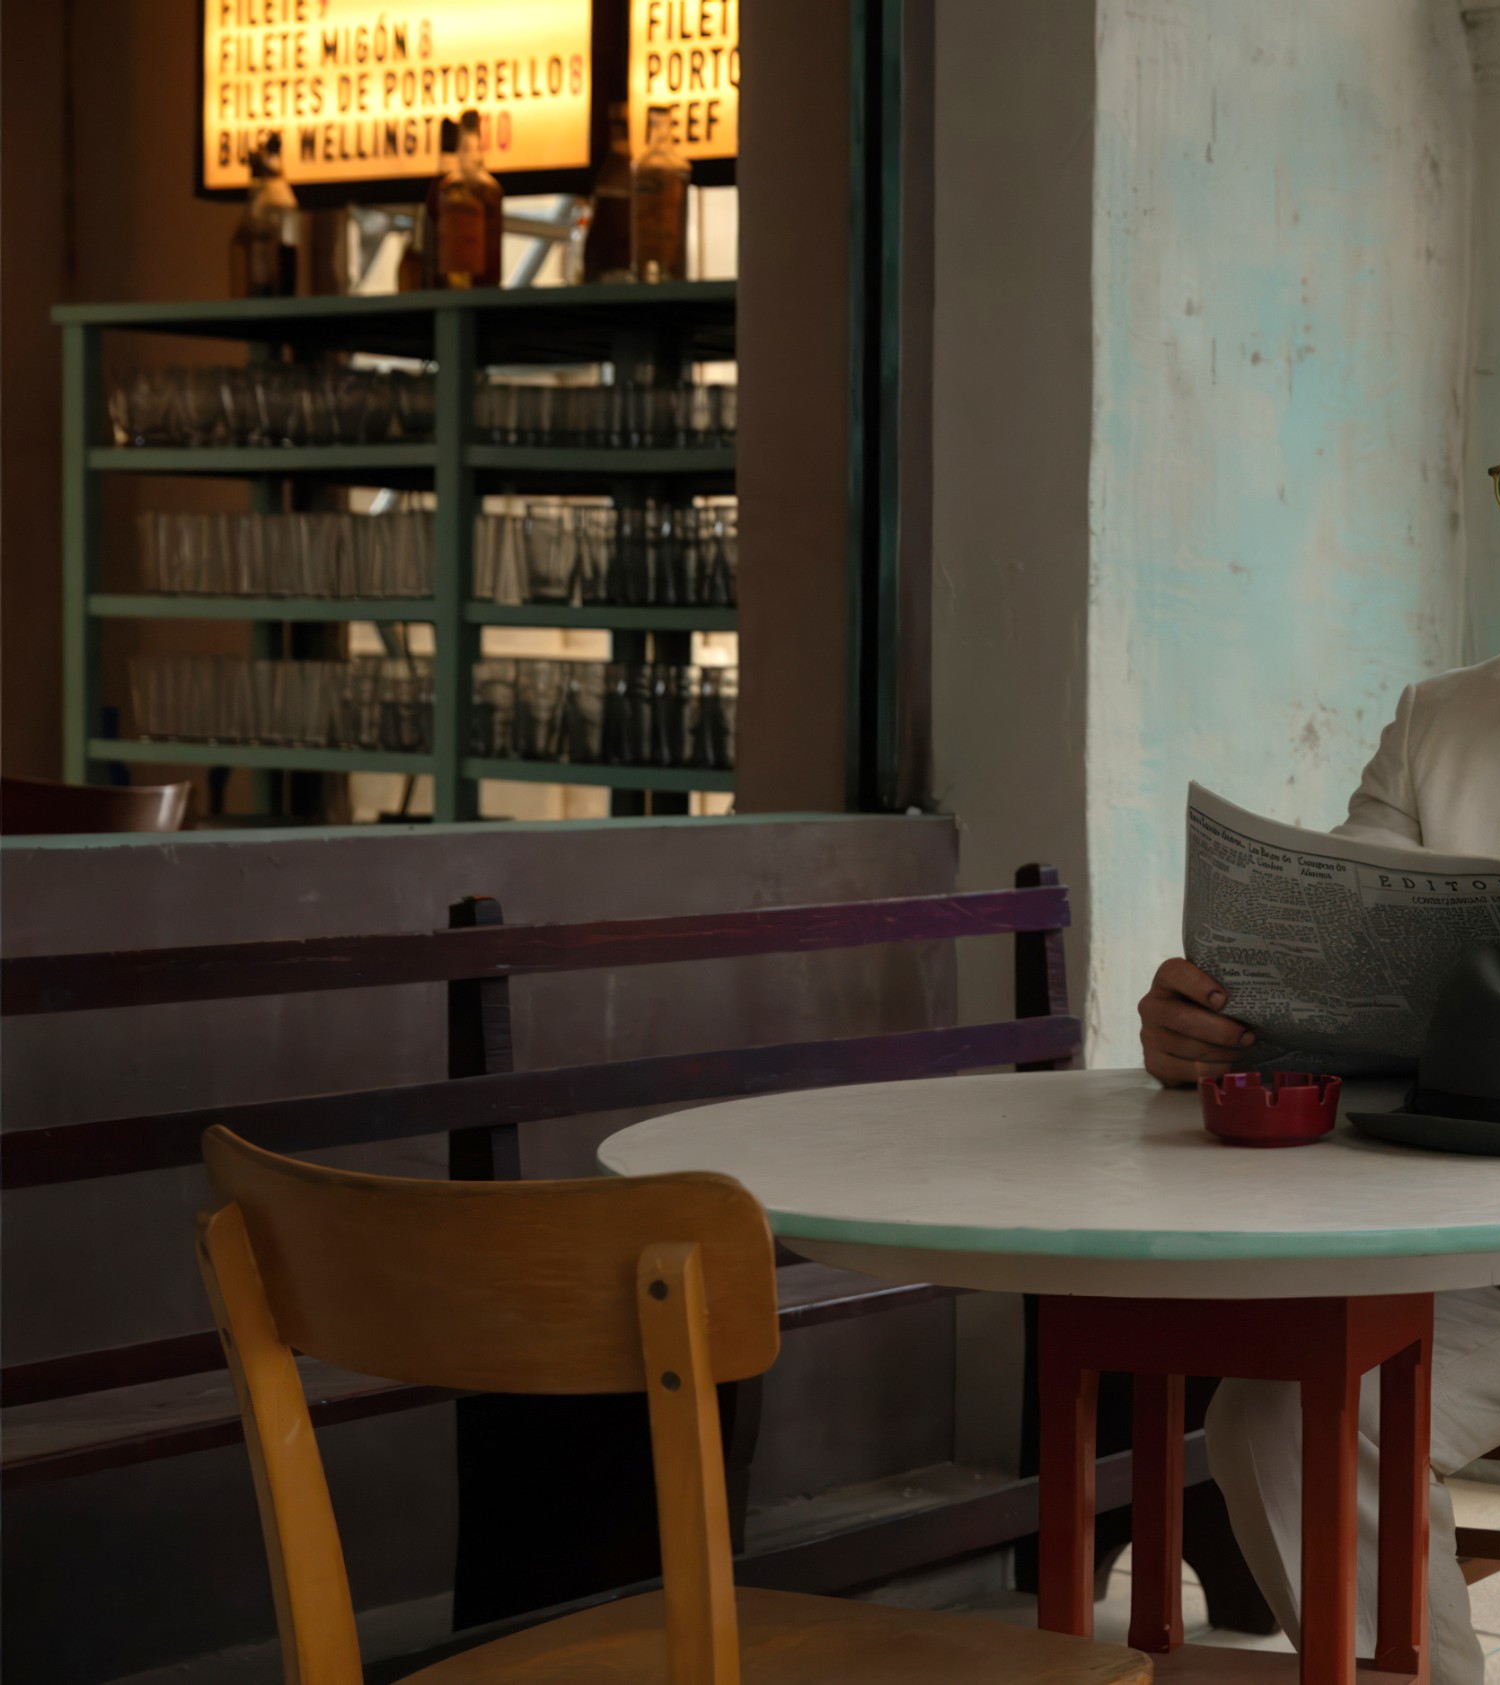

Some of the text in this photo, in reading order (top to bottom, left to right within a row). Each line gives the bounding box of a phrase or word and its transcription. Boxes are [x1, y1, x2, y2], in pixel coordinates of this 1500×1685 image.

[220, 31, 305, 74] FILETE
[320, 12, 406, 67] MIGÓN
[220, 77, 322, 119] FILETES
[338, 72, 368, 112] DE
[384, 54, 562, 110] PORTOBELLO
[299, 115, 433, 163] WELLINGT
[646, 100, 719, 143] EEF
